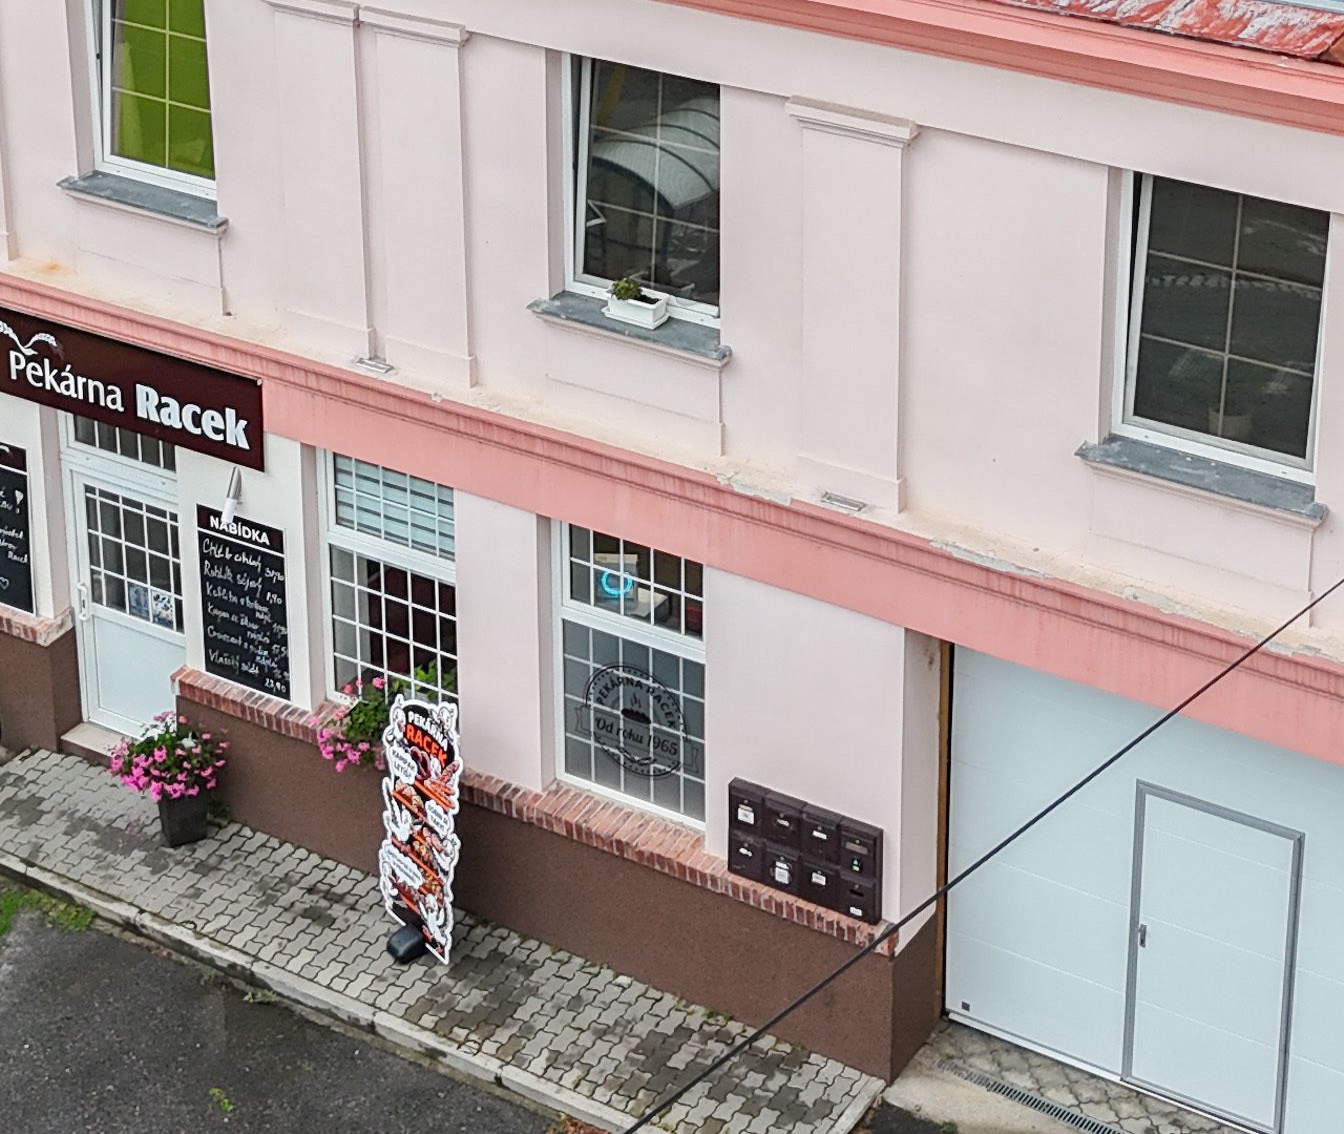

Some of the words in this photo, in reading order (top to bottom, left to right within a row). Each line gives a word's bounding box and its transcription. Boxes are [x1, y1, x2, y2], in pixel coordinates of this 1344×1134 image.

[9, 350, 125, 413] Pekárna
[135, 383, 251, 450] Racek
[209, 515, 271, 546] NABÍDKA
[646, 685, 676, 729] RACEK
[406, 723, 448, 769] RACEK
